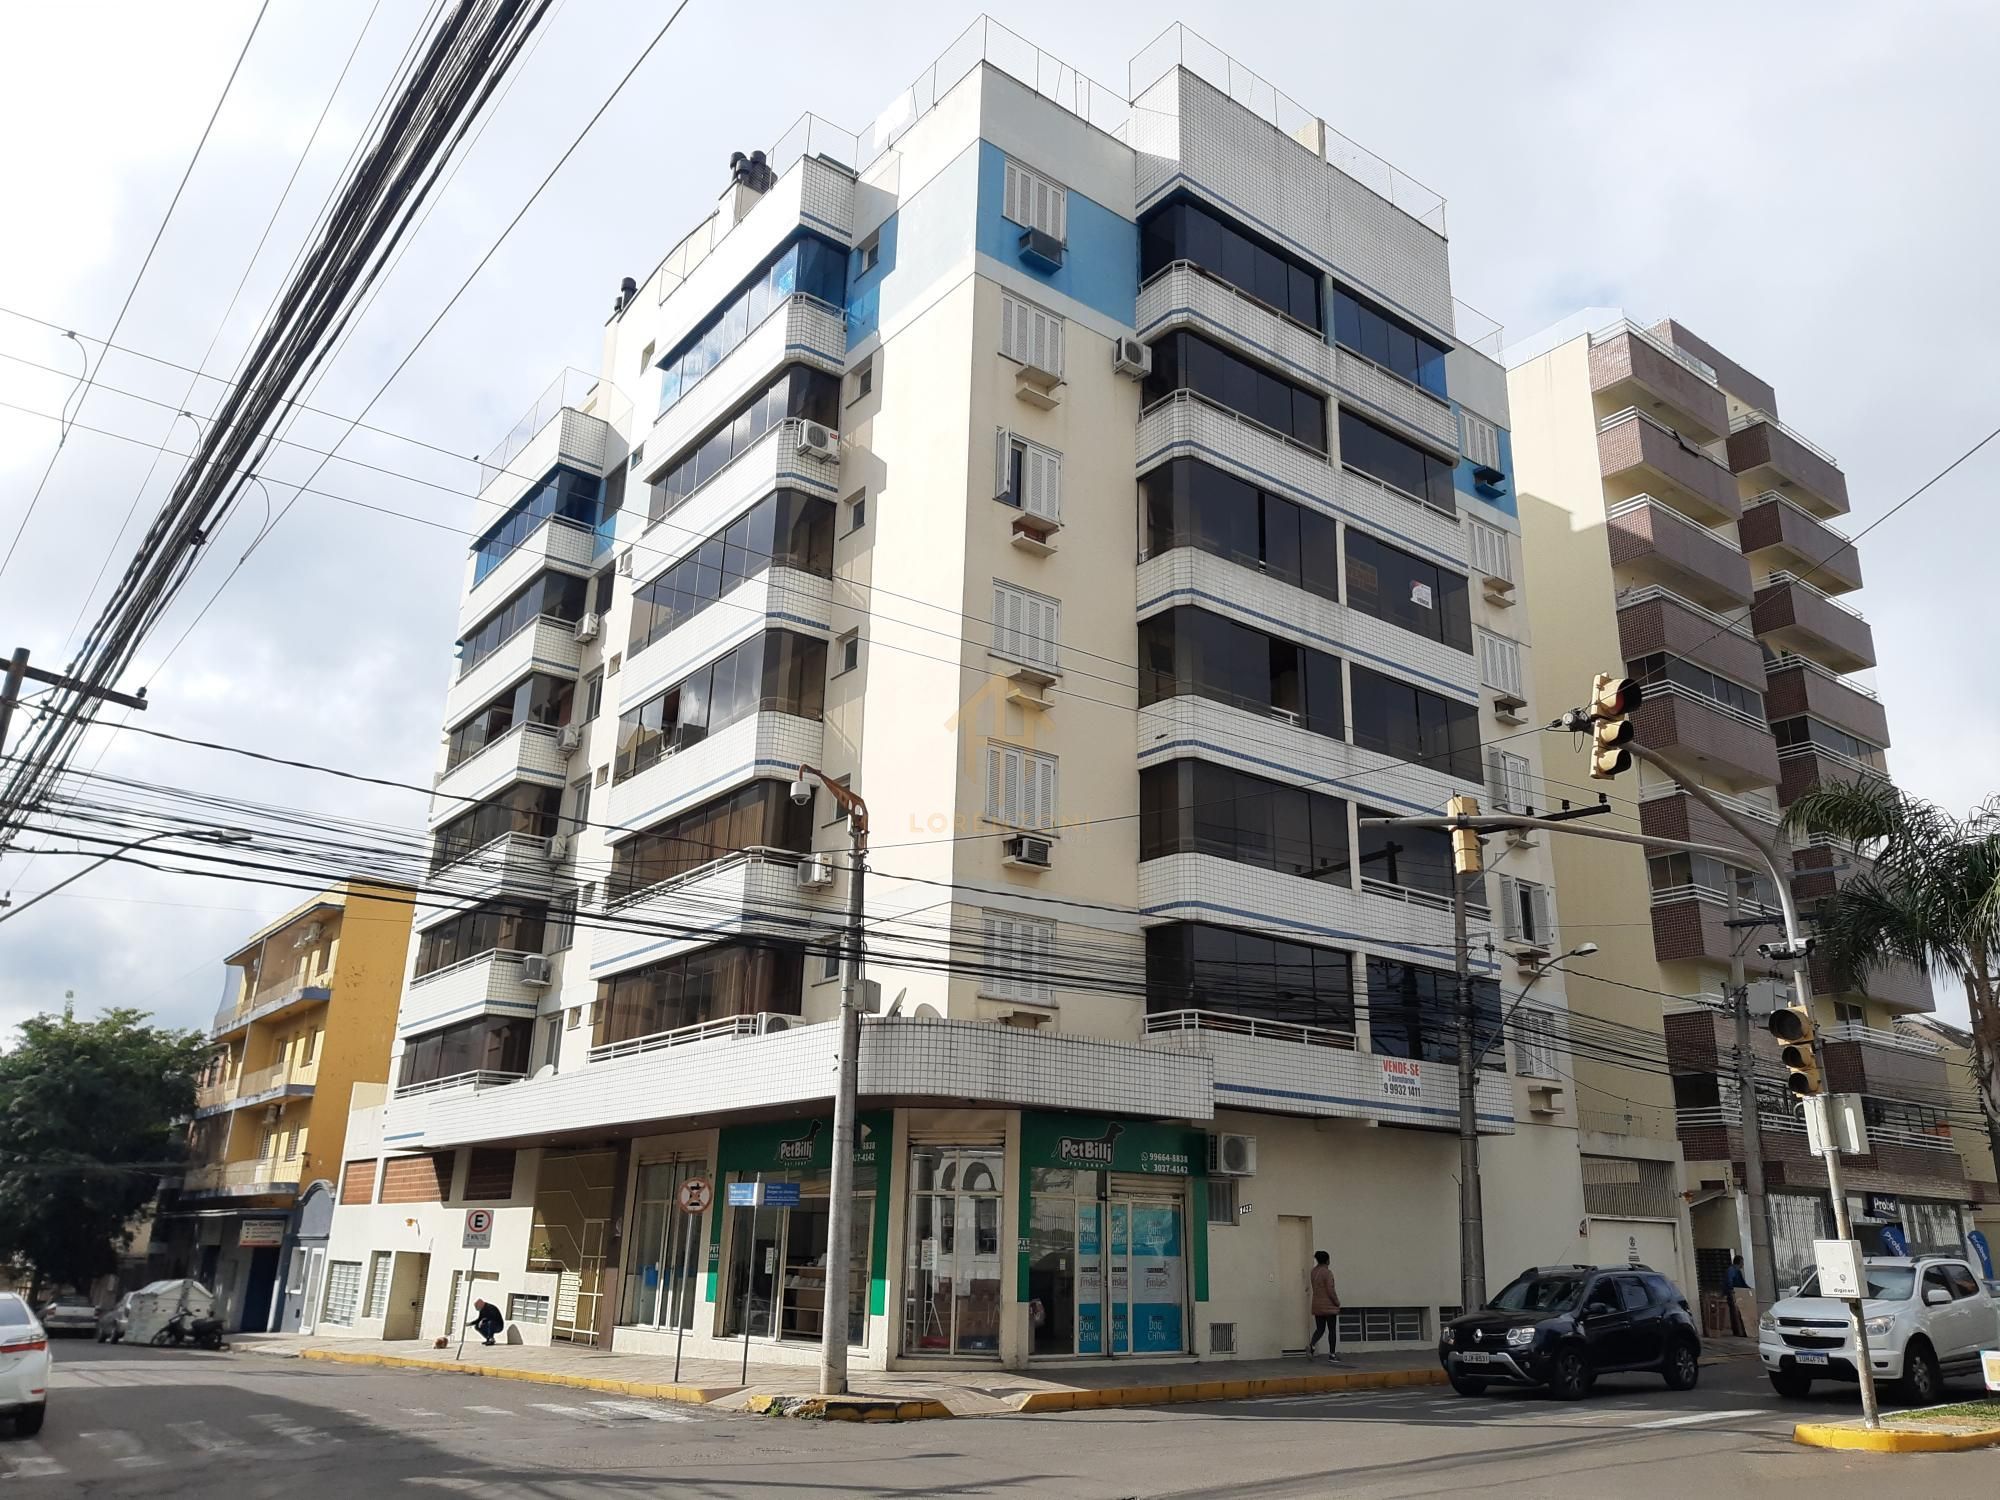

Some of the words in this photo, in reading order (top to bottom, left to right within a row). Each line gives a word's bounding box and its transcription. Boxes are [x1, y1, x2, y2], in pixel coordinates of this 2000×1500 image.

[1383, 1060, 1419, 1076] VENDE-SE
[1384, 1083, 1388, 1093] 9
[1408, 1087, 1420, 1097] 1411
[1873, 1196, 1897, 1212] Probel
[474, 1214, 485, 1228] E
[1080, 1331, 1099, 1341] CHOW
